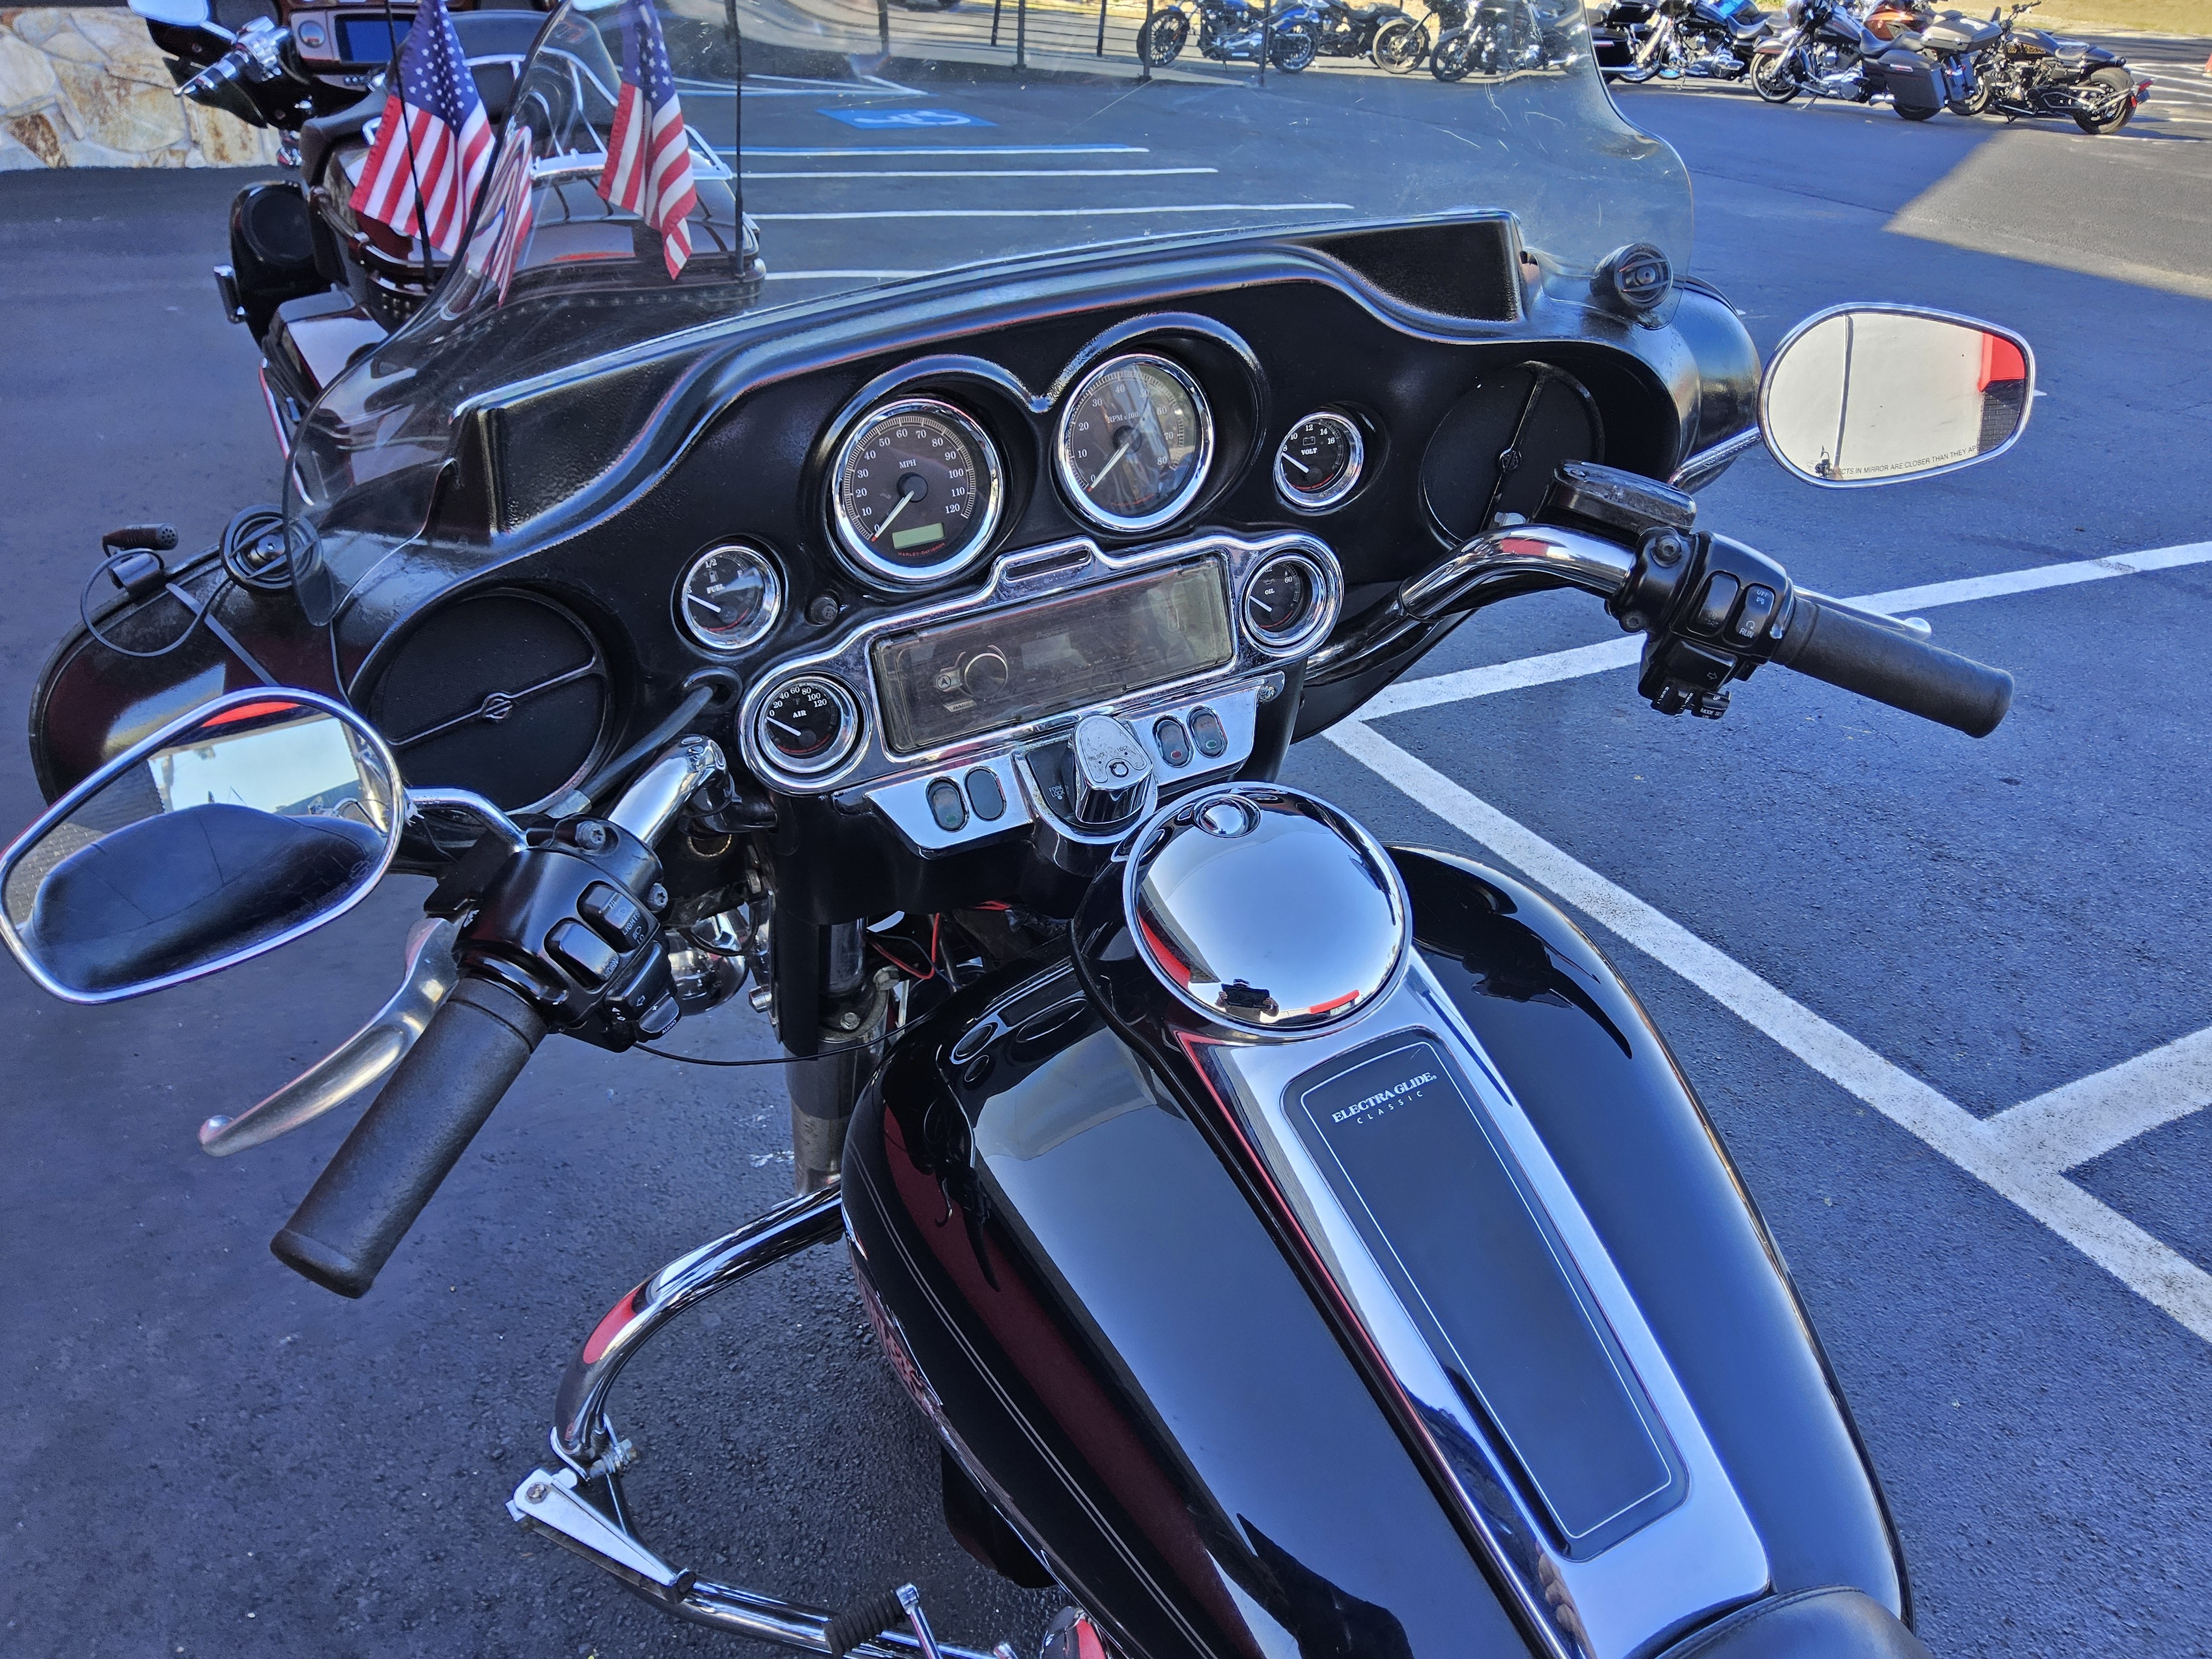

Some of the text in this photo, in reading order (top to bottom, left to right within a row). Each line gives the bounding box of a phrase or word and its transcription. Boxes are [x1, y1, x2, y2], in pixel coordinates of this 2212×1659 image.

[1115, 385, 1125, 393] 40
[1140, 388, 1150, 398] 50
[1092, 398, 1102, 407] 30
[1157, 406, 1167, 415] 60
[1108, 413, 1123, 423] RPM
[1128, 411, 1139, 420] 100
[1079, 422, 1089, 431] 20
[896, 429, 908, 438] 60
[915, 430, 927, 439] 70
[1164, 431, 1174, 440] 70
[879, 437, 891, 447] 50
[932, 437, 944, 447] 80
[1327, 437, 1335, 445] 16
[864, 450, 876, 460] 40
[945, 451, 956, 461] 90
[1078, 450, 1087, 458] 10
[899, 459, 917, 469] MPH
[1157, 456, 1168, 466] 80
[1864, 465, 1889, 474] MIRROR
[1890, 462, 1903, 470] ARE
[1904, 458, 1930, 468] CLOSER
[1932, 454, 1948, 463] THAN
[1950, 449, 1967, 458] THEY
[857, 469, 869, 478] 30
[948, 469, 964, 479] 100
[1091, 474, 1096, 482] 0
[856, 488, 867, 497] 20
[951, 487, 965, 497] 110
[862, 506, 872, 516] 10
[945, 503, 960, 514] 120
[874, 524, 880, 532] 0
[705, 558, 718, 569] 1/2
[706, 584, 725, 594] FUEL
[1739, 627, 1754, 638] RUN
[790, 686, 800, 694] 60
[802, 687, 811, 695] 80
[779, 691, 789, 699] 40
[807, 692, 821, 701] 100
[773, 700, 783, 708] 20
[813, 699, 827, 707] 120
[793, 710, 807, 719] AIR
[1049, 784, 1063, 793] FORK
[1051, 790, 1065, 798] LOCK
[622, 911, 640, 936] LIGHTS
[662, 1019, 677, 1034] AUDIO
[1332, 1089, 1395, 1123] ELECTRA
[1357, 1090, 1423, 1124] CLASSIC
